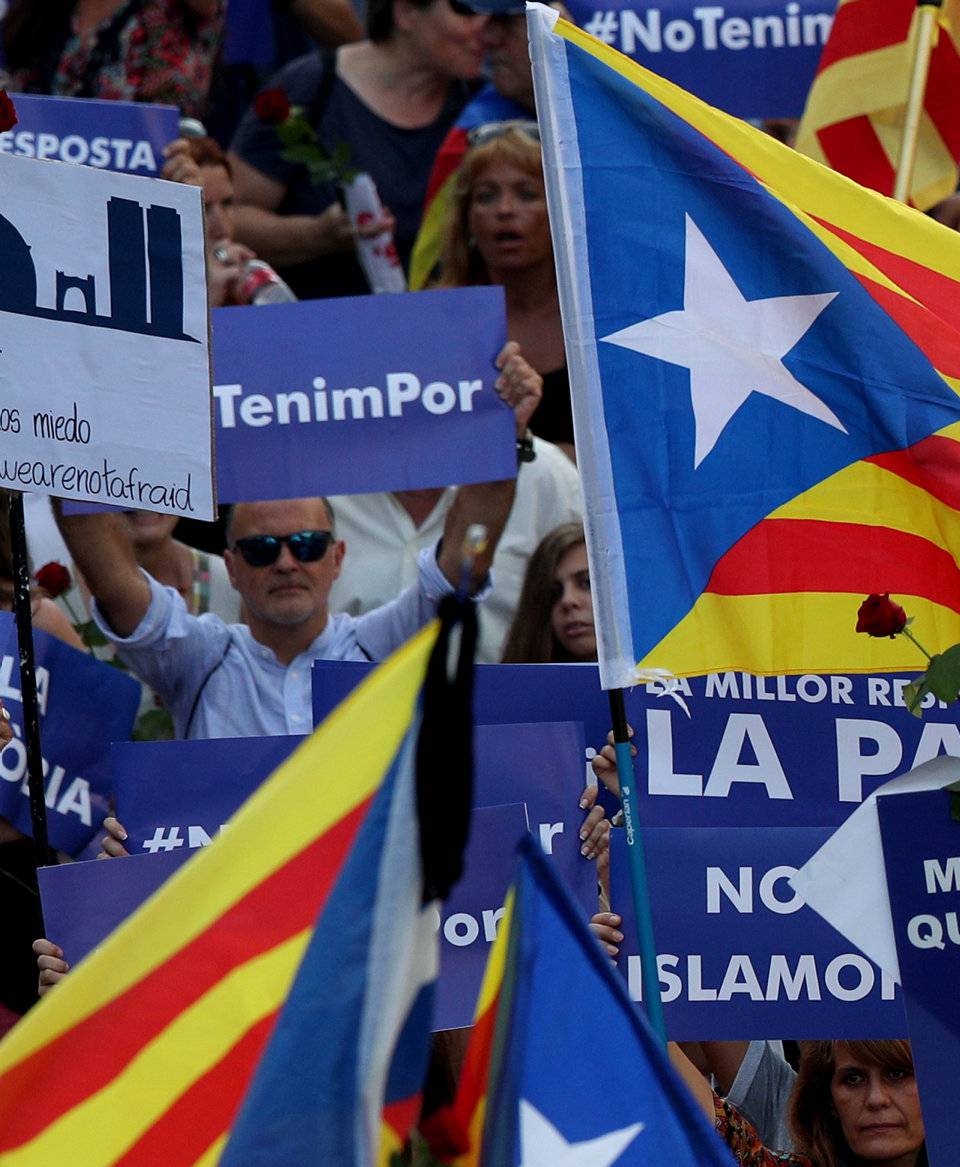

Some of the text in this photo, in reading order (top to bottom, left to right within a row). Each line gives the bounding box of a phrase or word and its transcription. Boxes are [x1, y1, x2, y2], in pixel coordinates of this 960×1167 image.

[33, 402, 91, 444] miedo
[212, 372, 483, 429] TenimPor
[704, 671, 854, 705] MILLOR
[646, 709, 794, 800] LA
[706, 865, 808, 914] NO
